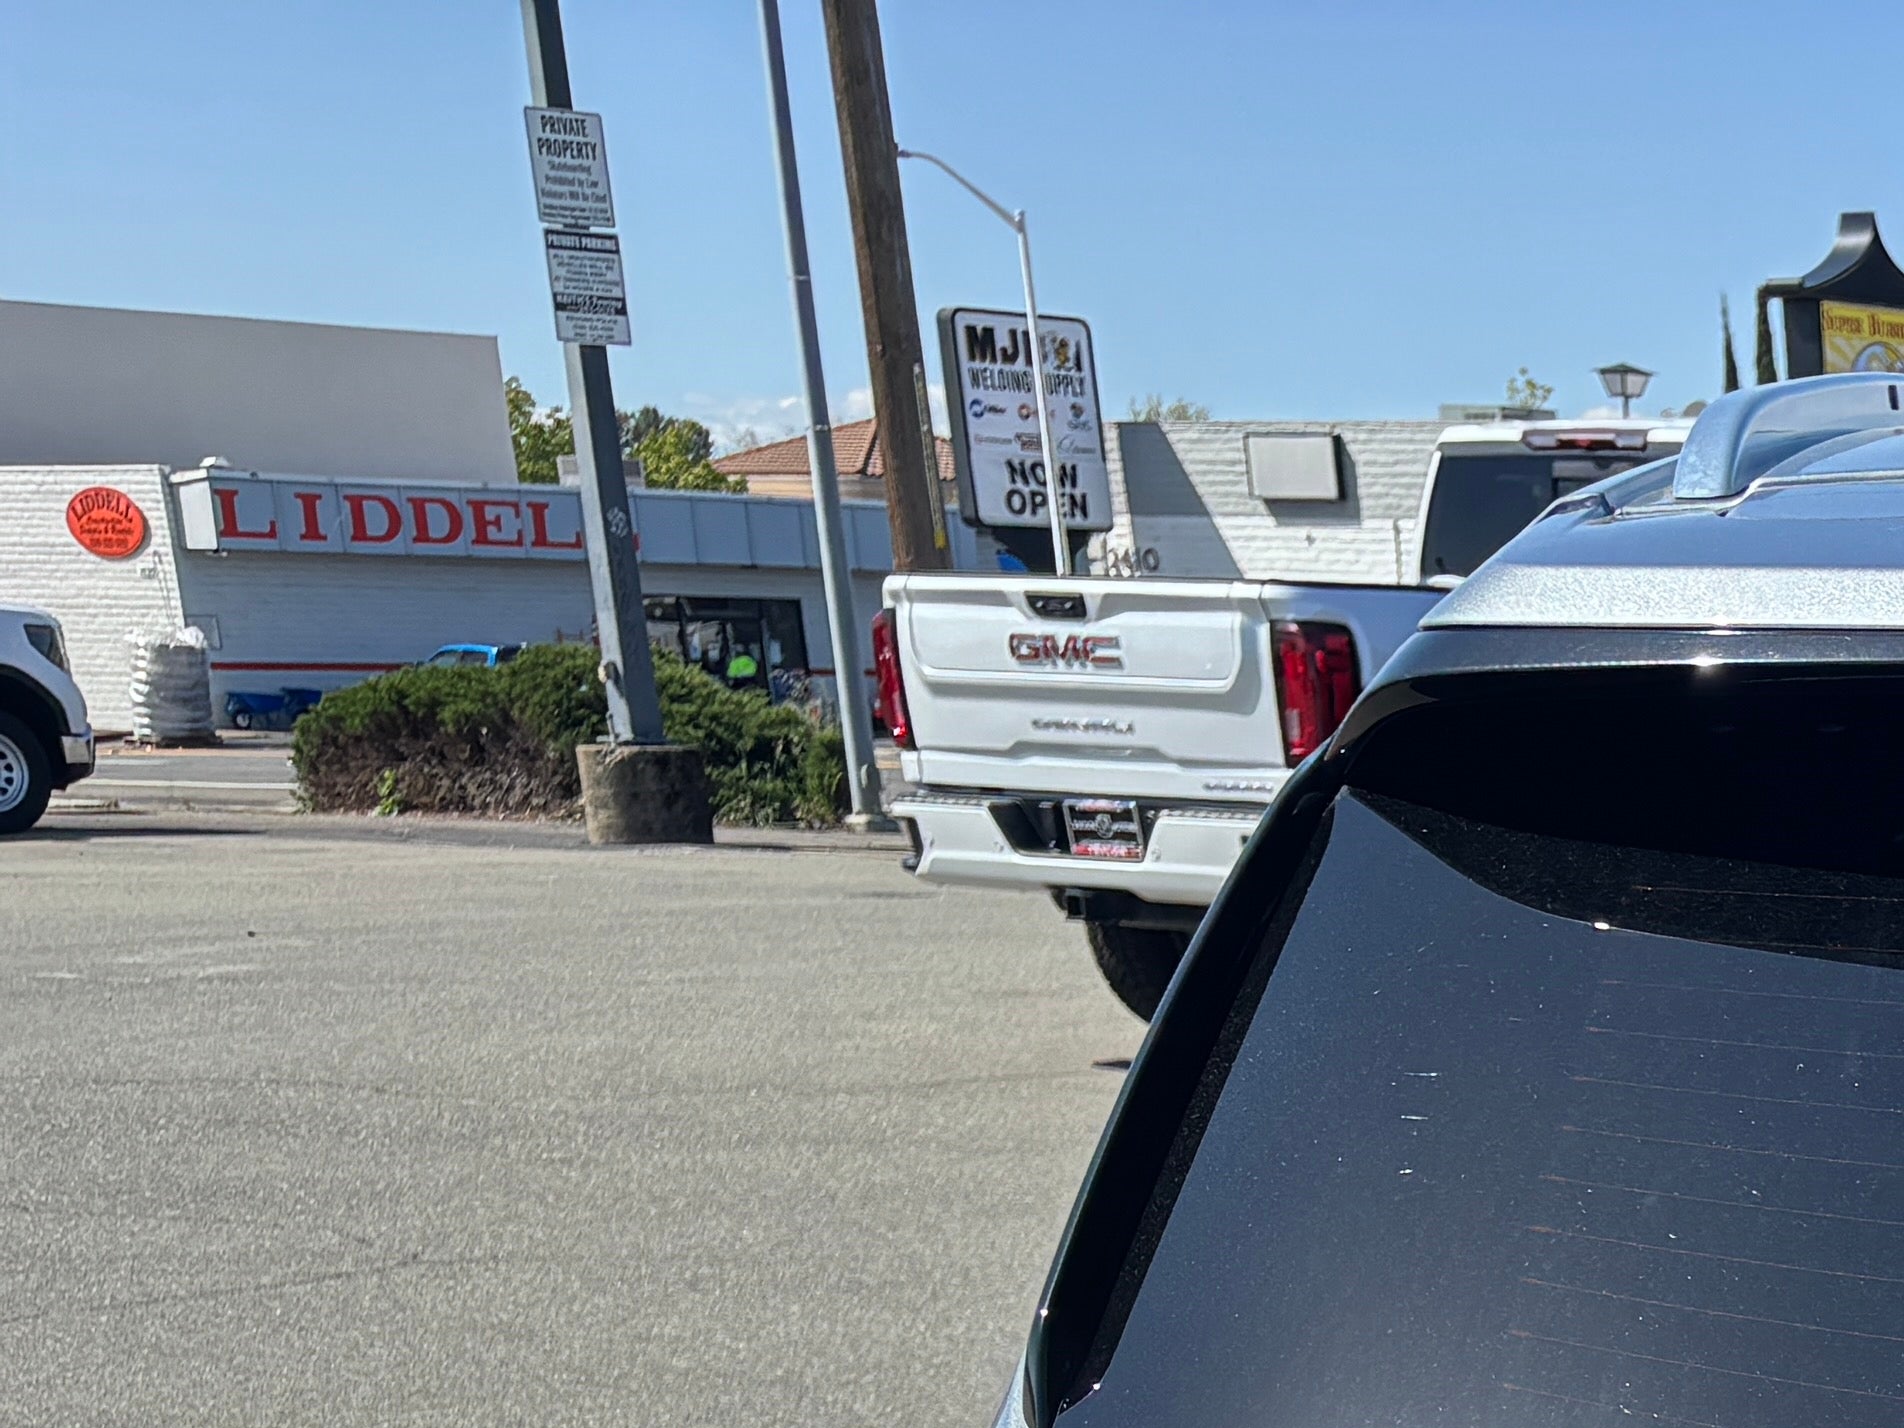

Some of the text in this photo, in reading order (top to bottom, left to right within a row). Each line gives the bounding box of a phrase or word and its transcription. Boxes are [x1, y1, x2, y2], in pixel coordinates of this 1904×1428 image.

[540, 115, 588, 138] PRIVATE
[537, 138, 597, 161] PROPERTY
[968, 367, 1086, 398] WELDING UPPLY
[1005, 459, 1077, 489] NOW
[71, 491, 133, 524] LIDDELL
[214, 488, 639, 552] LIDDEL
[1009, 633, 1123, 670] GMC
